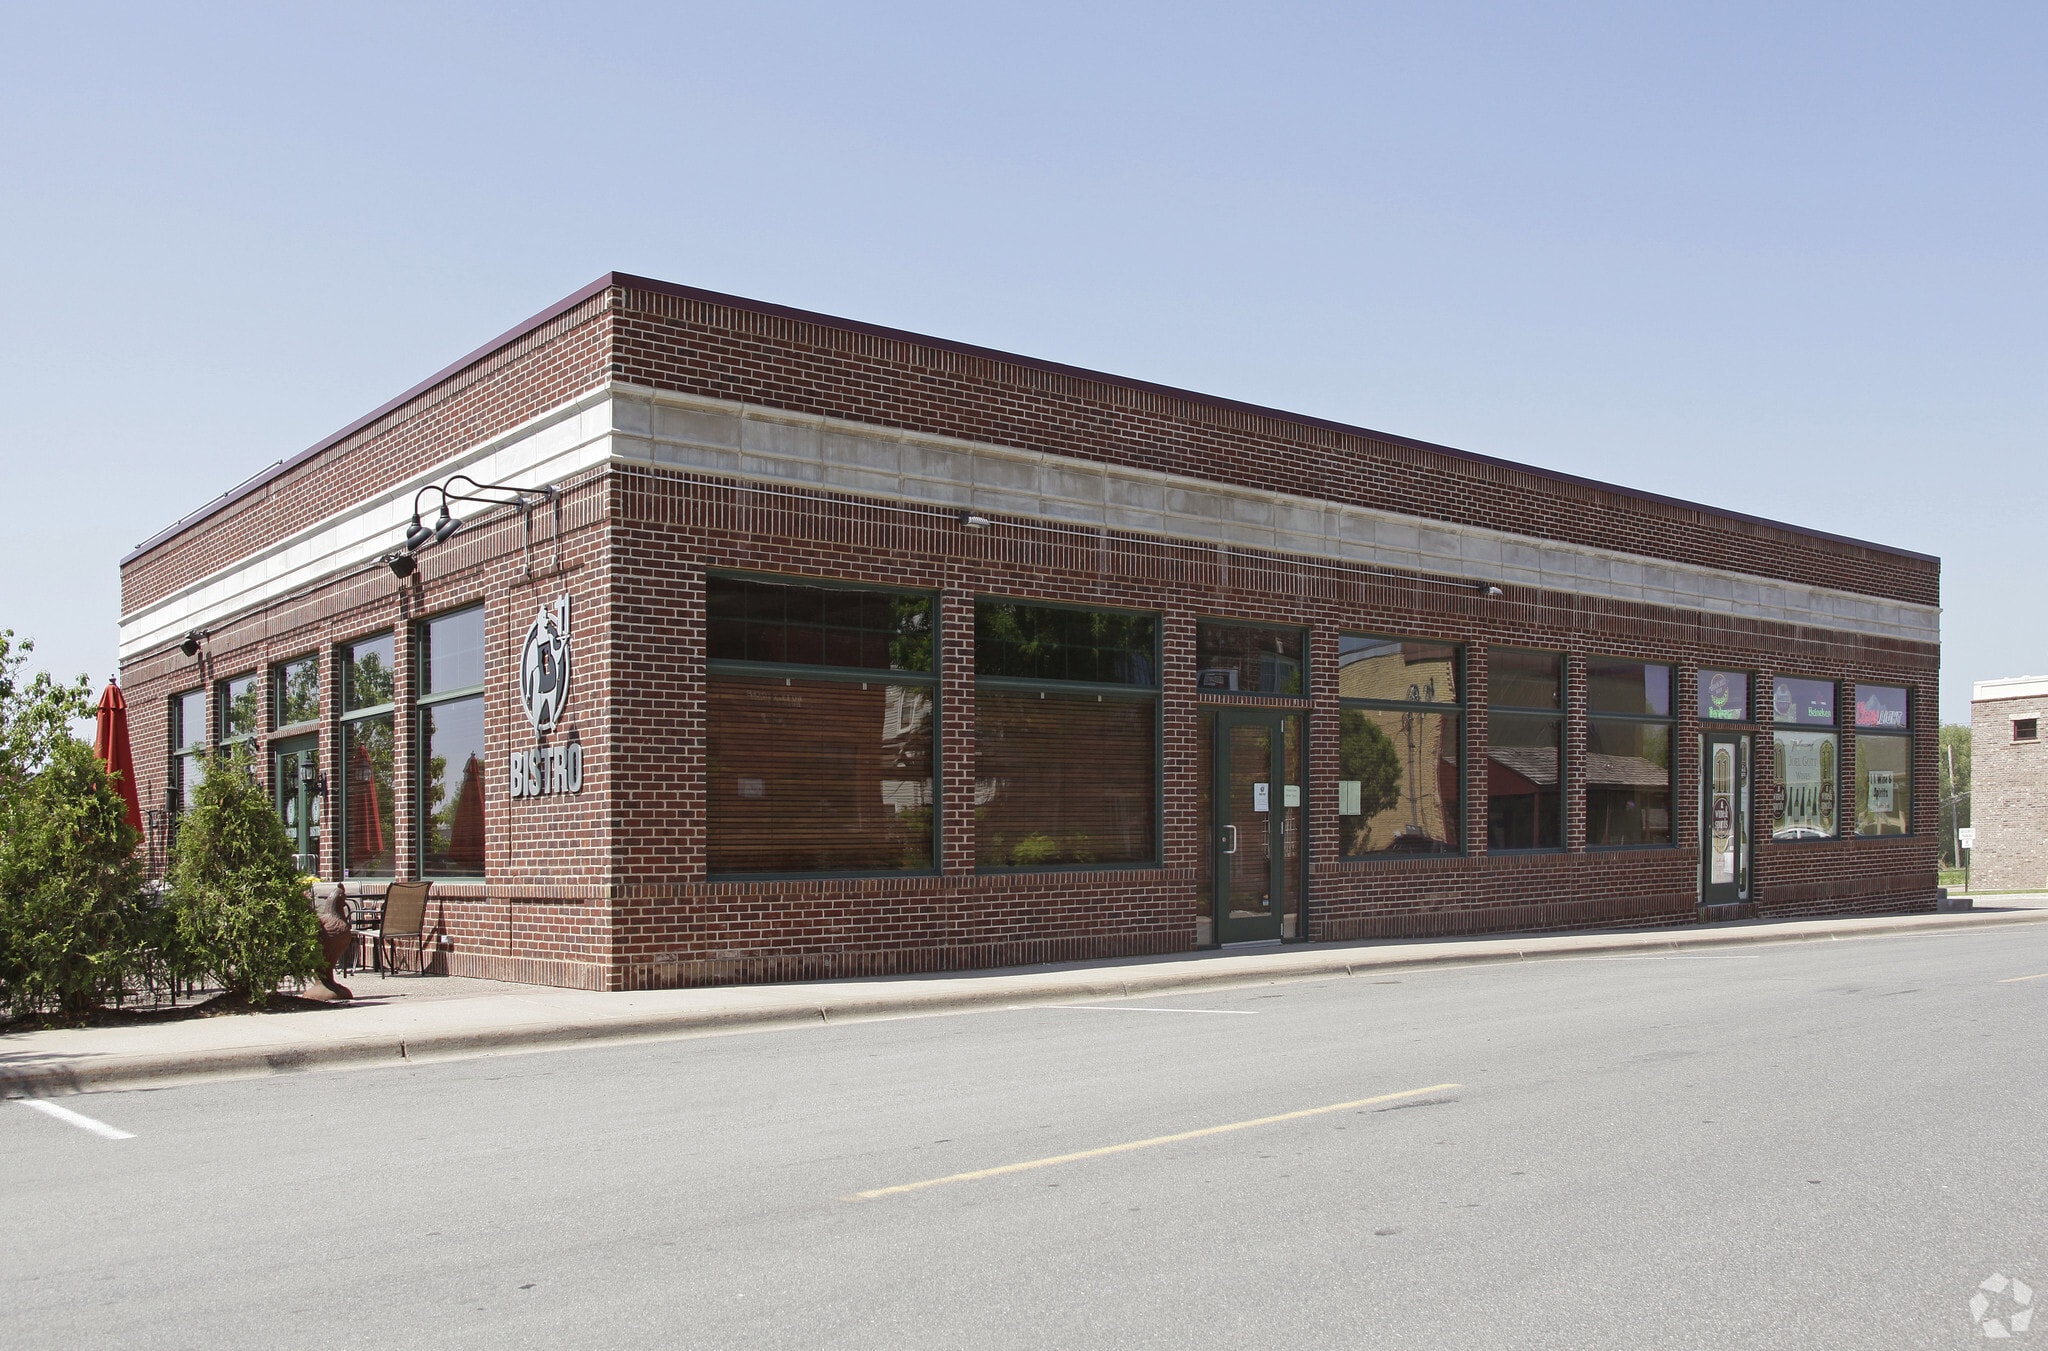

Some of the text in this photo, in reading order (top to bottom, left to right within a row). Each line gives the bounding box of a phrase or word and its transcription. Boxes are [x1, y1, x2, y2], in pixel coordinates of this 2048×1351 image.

[1808, 707, 1831, 718] Heineken
[511, 743, 582, 796] BISTRO
[1717, 759, 1728, 793] 11
